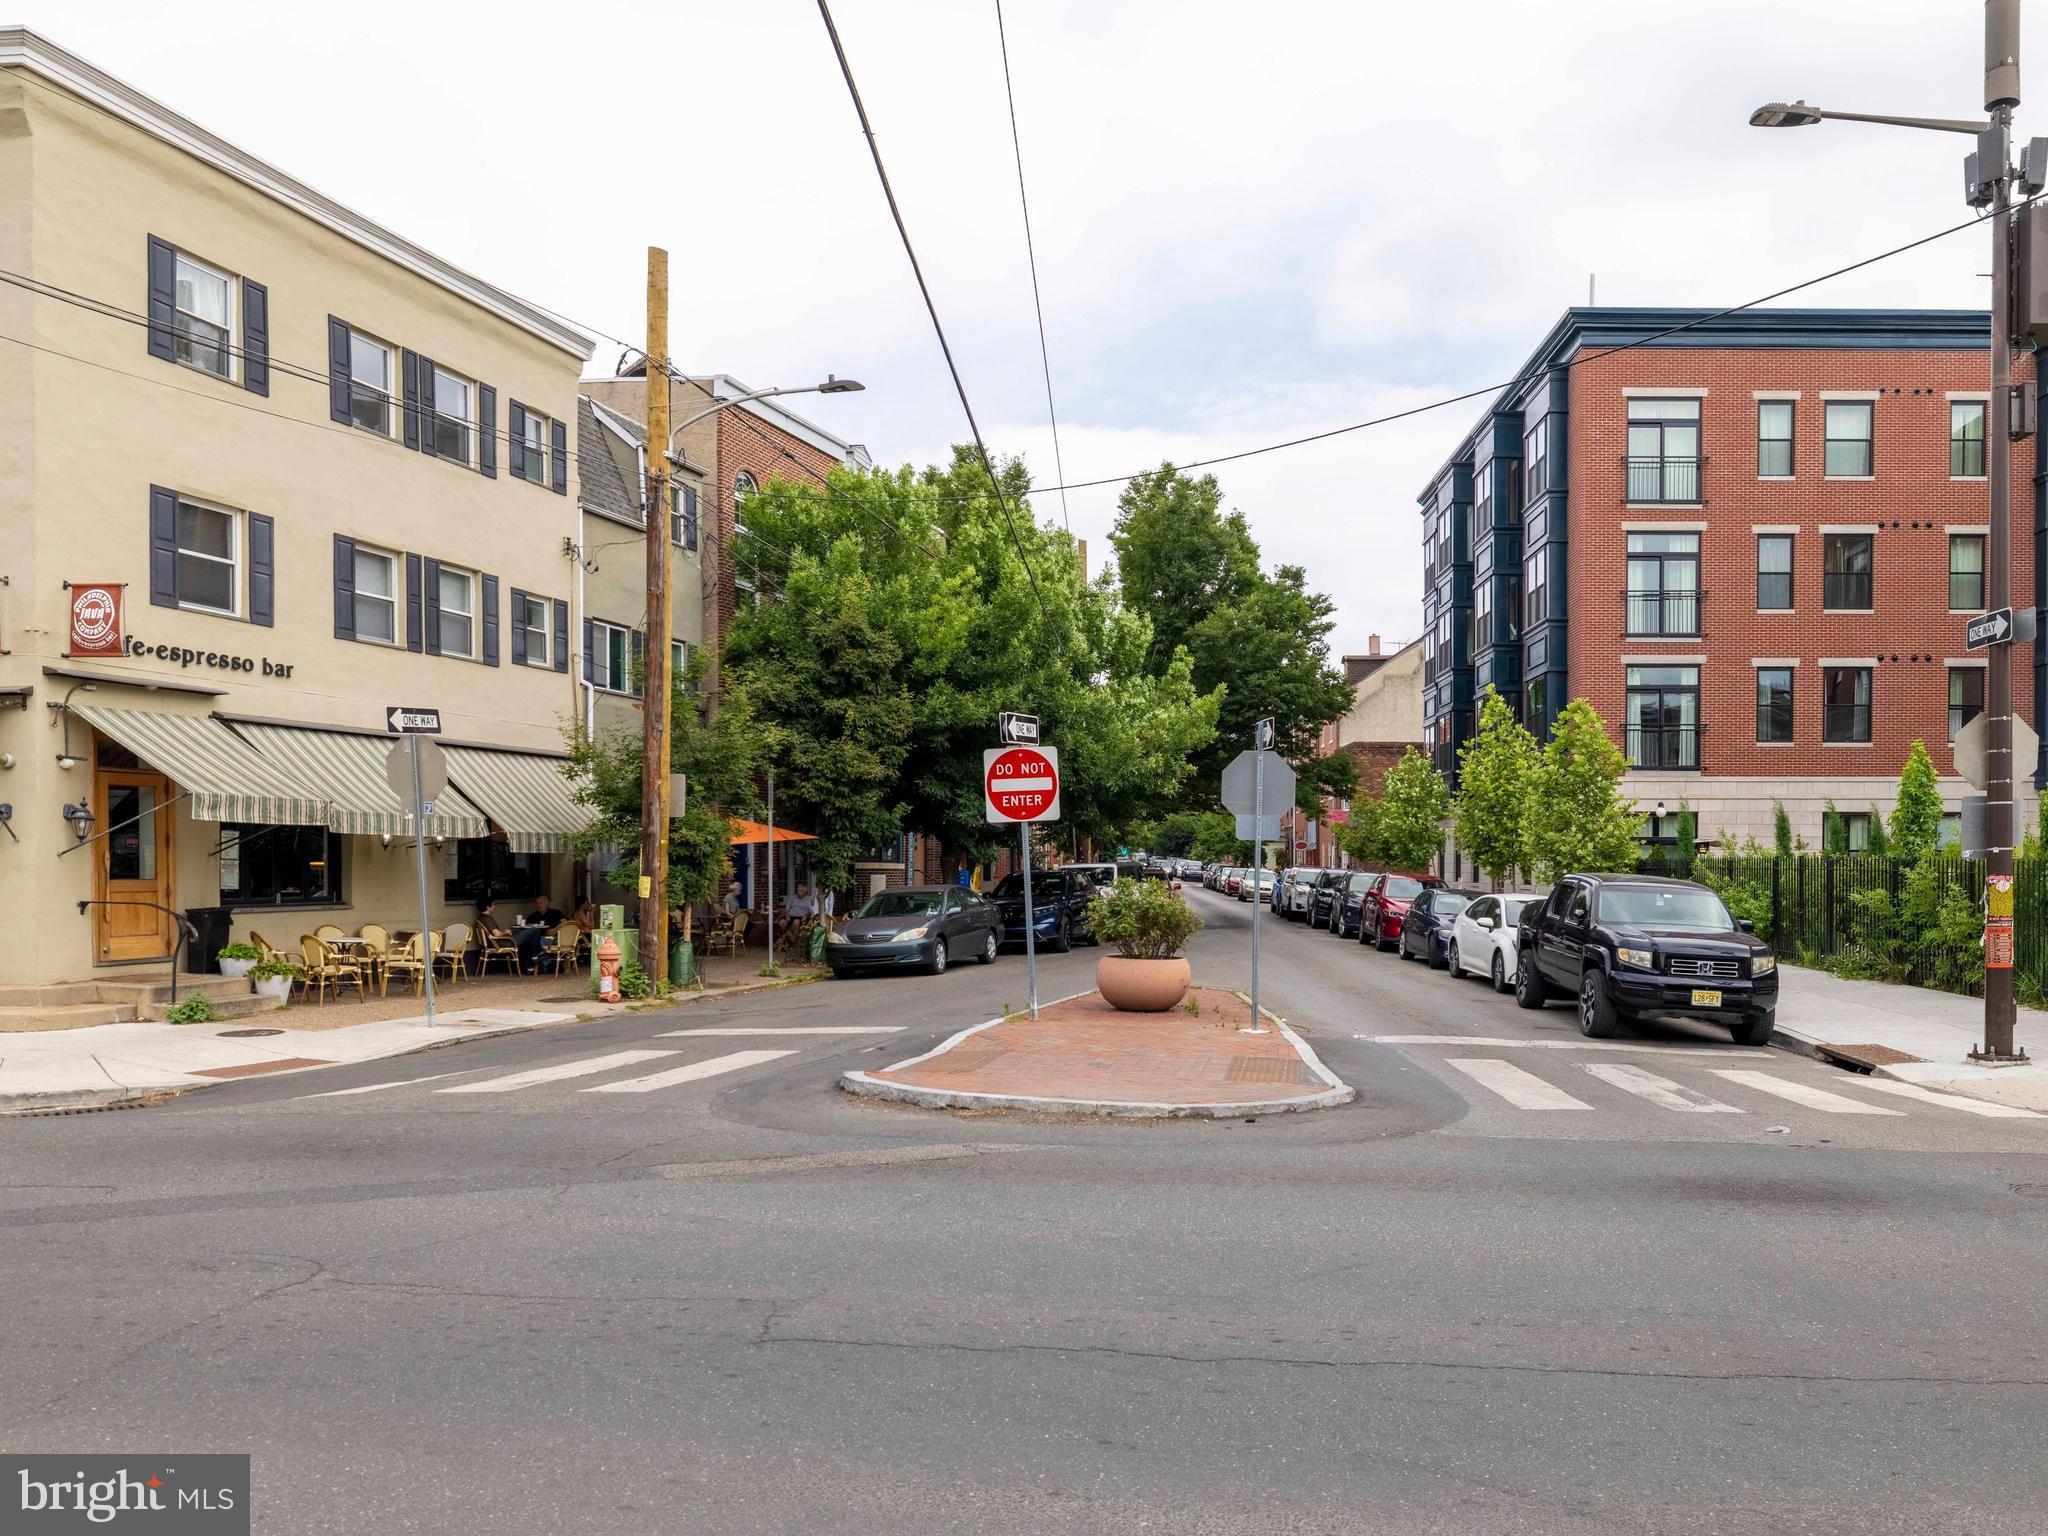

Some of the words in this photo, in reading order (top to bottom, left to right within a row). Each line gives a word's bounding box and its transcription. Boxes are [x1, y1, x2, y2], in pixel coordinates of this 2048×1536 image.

[74, 592, 112, 613] PHILADELPHIA
[80, 607, 105, 620] JAVA
[77, 621, 107, 635] COMPANY
[1970, 627, 1982, 640] ONE
[1982, 621, 1997, 636] WAY
[261, 657, 294, 679] bar
[403, 715, 419, 726] ONE
[420, 716, 435, 727] WAY
[1016, 723, 1025, 735] ONE
[1026, 724, 1036, 737] WAY
[996, 763, 1014, 776] DO
[1021, 762, 1046, 775] NOT
[1002, 794, 1043, 808] ENTER
